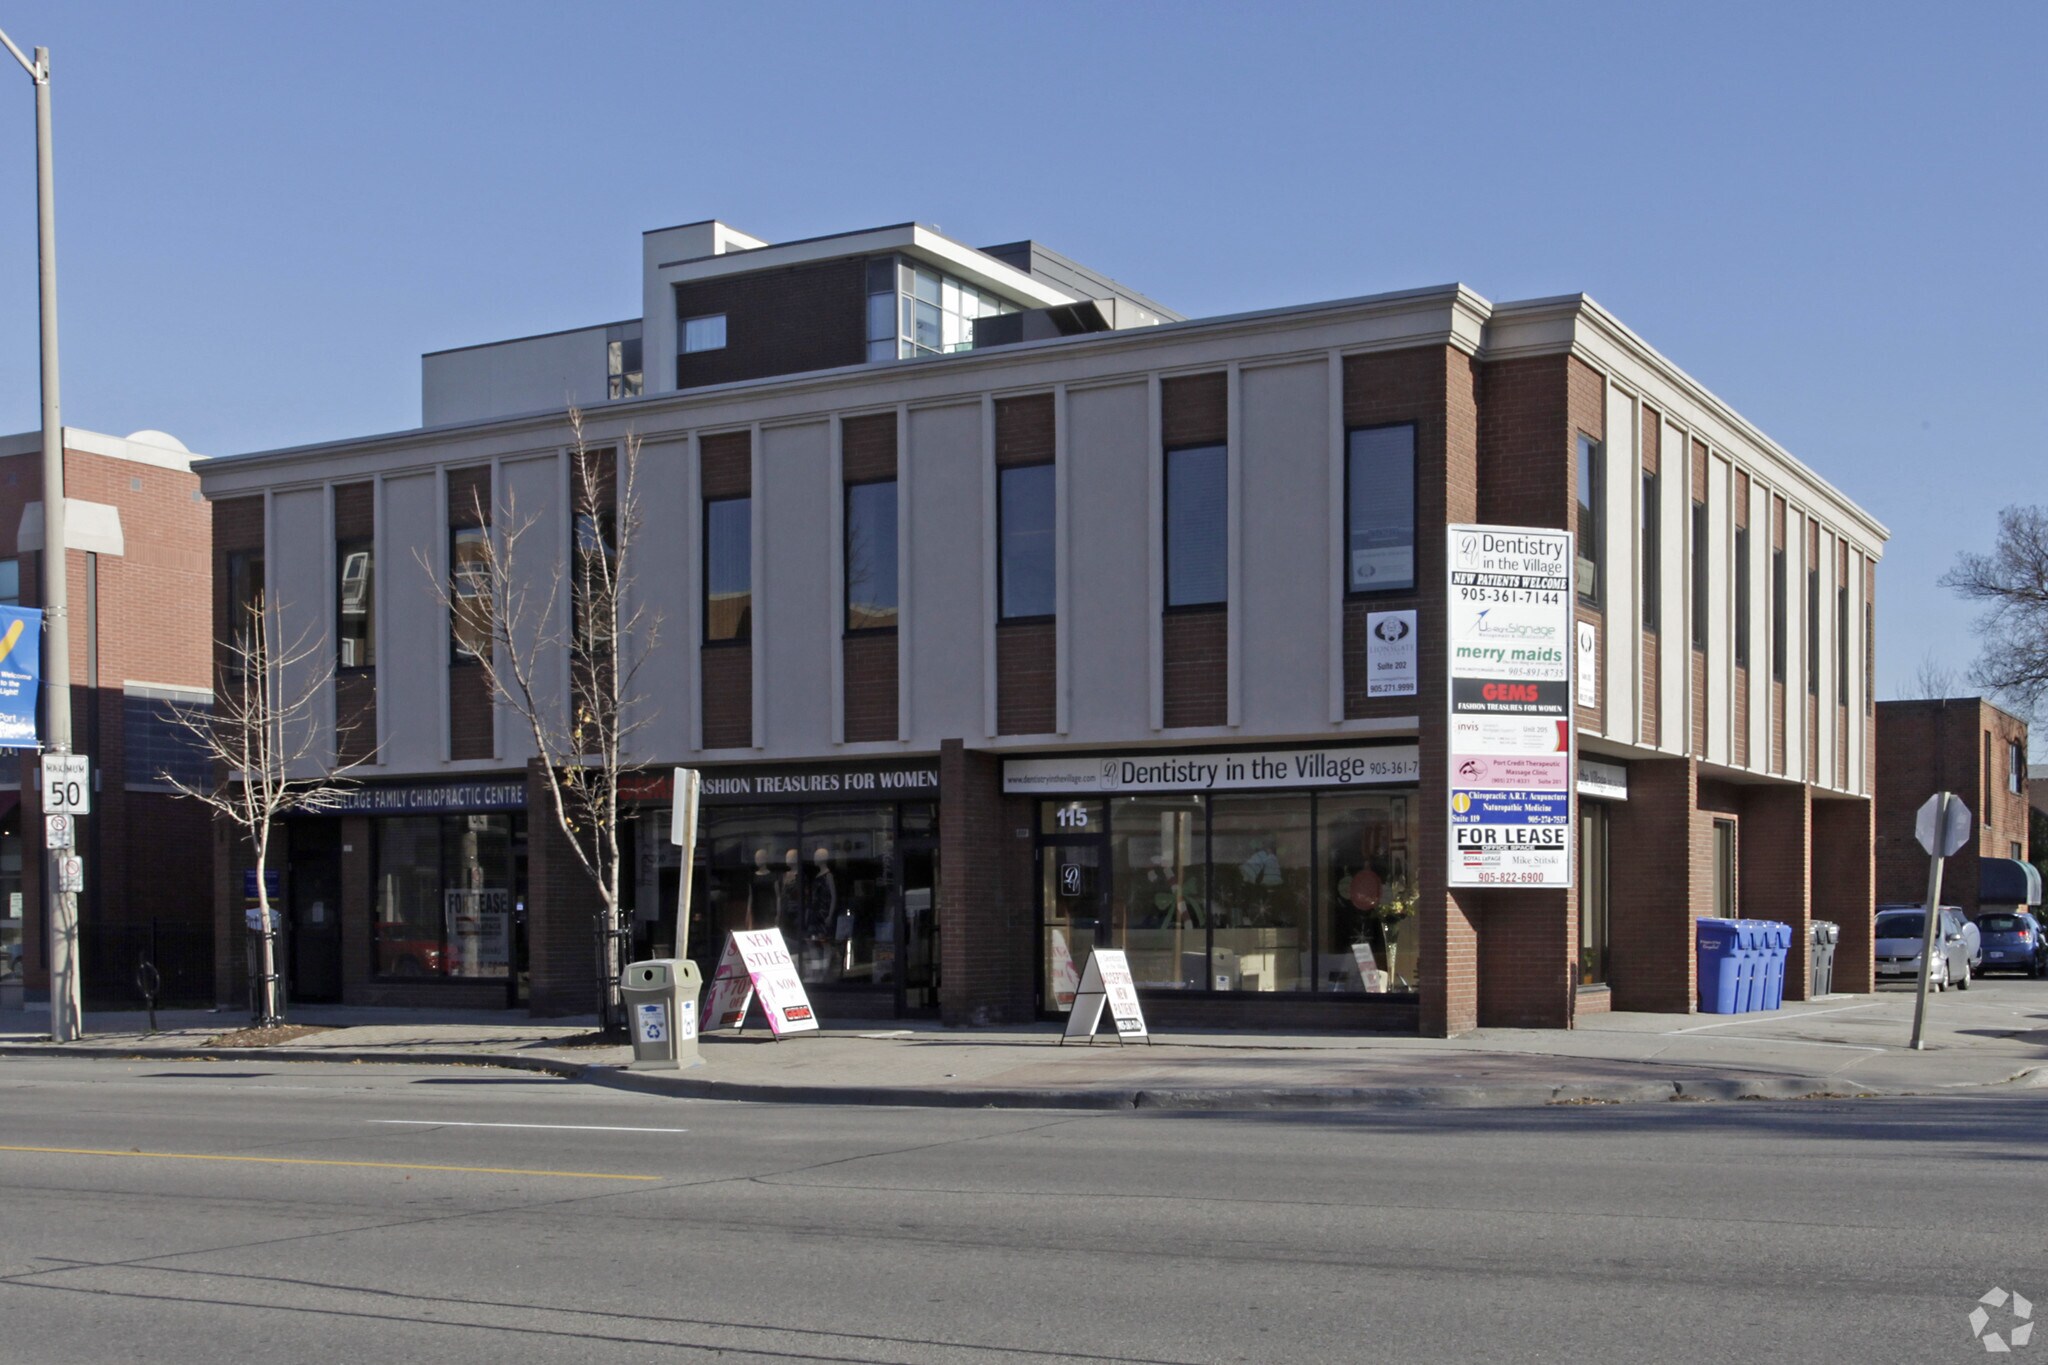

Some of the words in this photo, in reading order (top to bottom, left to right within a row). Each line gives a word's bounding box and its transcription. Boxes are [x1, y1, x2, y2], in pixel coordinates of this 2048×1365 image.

[1483, 534, 1563, 561] Dentistry
[1483, 558, 1494, 569] in
[1498, 558, 1519, 571] the
[1523, 559, 1562, 576] Village
[1453, 572, 1476, 585] NEW
[1476, 574, 1520, 588] PATIENTS
[1522, 576, 1567, 590] WELCOME
[1461, 587, 1559, 604] 905-361-7144
[1456, 646, 1505, 662] merry
[1511, 647, 1562, 662] maids
[1377, 662, 1393, 670] Suite
[1395, 661, 1407, 669] 202
[1508, 667, 1564, 677] 905-891-8735
[1, 671, 32, 681] Welcome
[1482, 682, 1538, 702] GEMS
[1458, 703, 1485, 711] FASHION
[1487, 703, 1522, 711] TREASURES
[1523, 704, 1537, 712] FOR
[1538, 705, 1562, 713] WOMEN
[1458, 721, 1479, 731] invis
[46, 764, 85, 774] MAXIMUM
[1007, 773, 1096, 785] www.dentistryinthevillage.com
[1122, 759, 1218, 788] Dentistry
[1226, 757, 1244, 781] in
[1252, 756, 1287, 780] the
[1295, 753, 1364, 783] Village
[1526, 760, 1560, 768] Therapeutic
[699, 777, 750, 795] ASHION
[755, 774, 840, 793] TREASURES
[844, 772, 875, 790] FOR
[880, 770, 938, 789] WOMEN
[52, 781, 80, 806] 50
[375, 788, 408, 808] FAMILY
[410, 786, 480, 807] CHIROPRACTIC
[484, 785, 523, 804] CENTRE
[1468, 791, 1507, 801] Chiropractic
[1508, 792, 1527, 800] A.R.T.
[1529, 792, 1566, 802] Acupuncture
[1483, 803, 1522, 812] Naturopathic
[1524, 803, 1552, 812] Medicine
[1057, 808, 1088, 827] 115
[1452, 815, 1468, 823] Suite
[1470, 815, 1480, 823] 119
[1457, 828, 1497, 843] FOR
[1505, 828, 1564, 844] LEASE
[1512, 856, 1532, 864] Mike
[1479, 872, 1544, 883] 905-822-6900
[746, 932, 773, 947] NEW
[746, 950, 790, 968] STYLES
[776, 978, 797, 989] NOW
[1116, 987, 1128, 1000] NEW
[784, 1005, 811, 1020] GEMS
